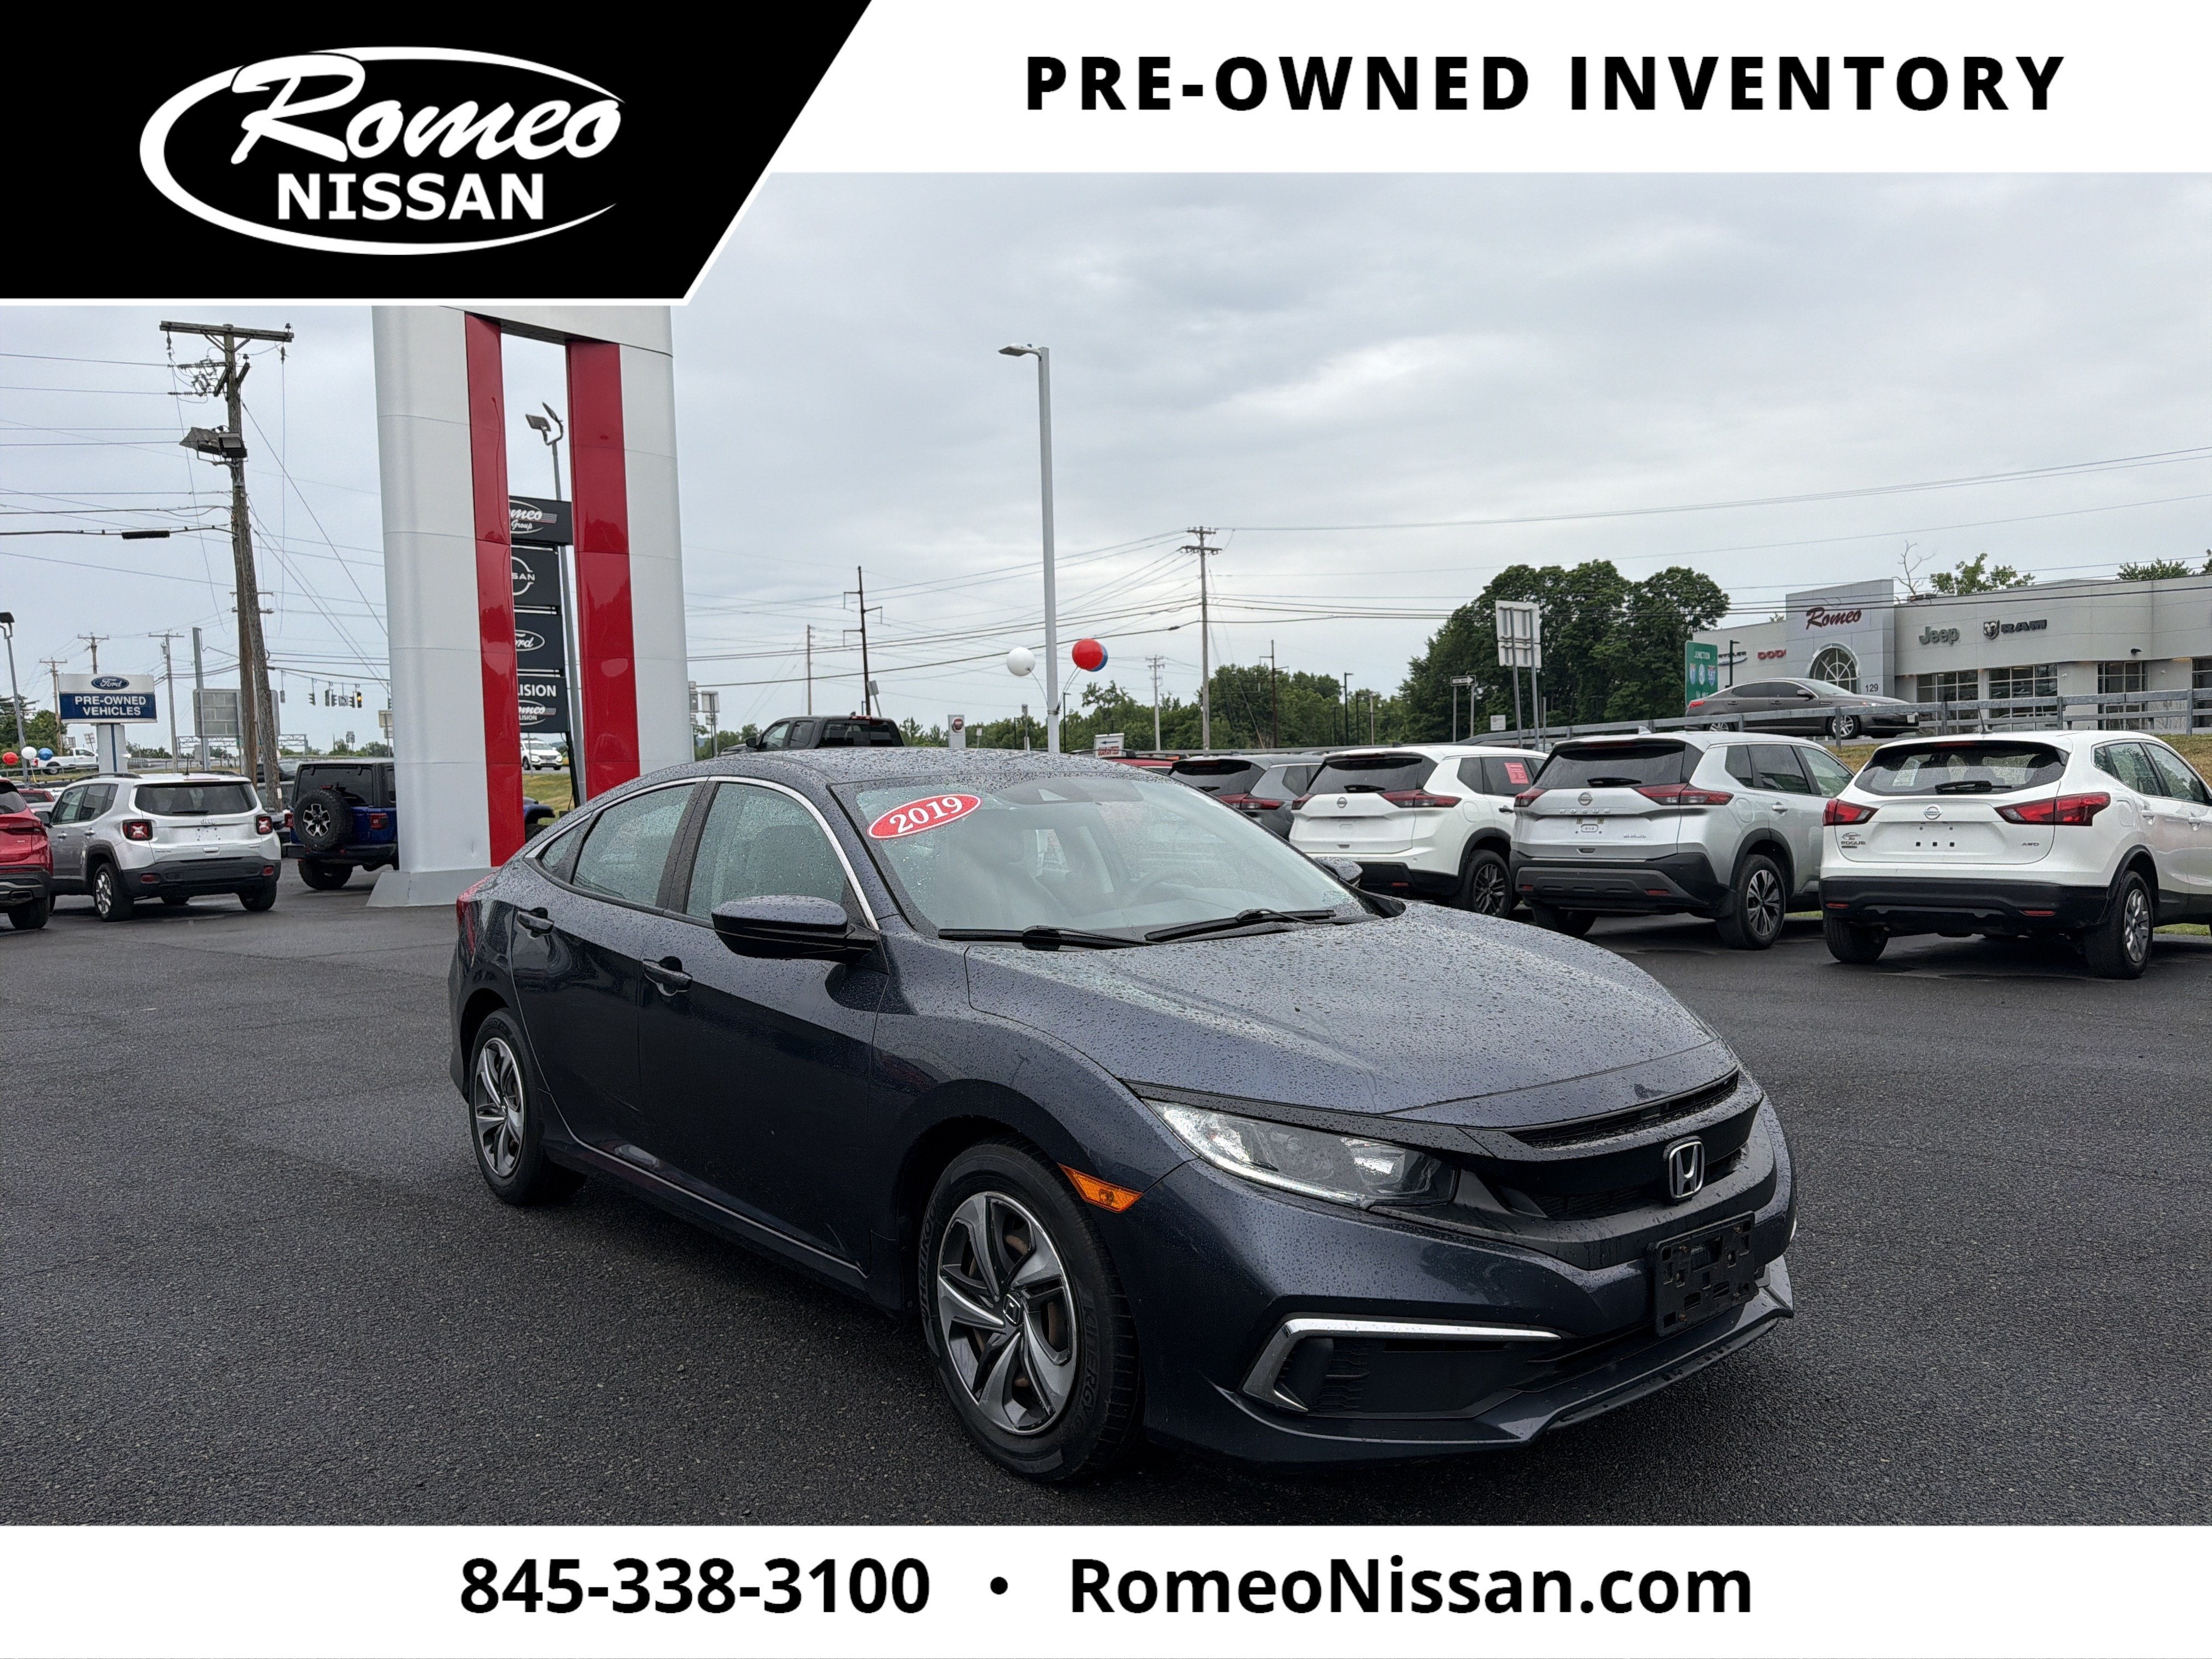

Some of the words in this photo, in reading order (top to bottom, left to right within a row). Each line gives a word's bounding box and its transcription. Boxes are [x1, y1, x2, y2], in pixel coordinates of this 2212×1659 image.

[510, 509, 543, 521] meo
[1805, 607, 1862, 630] Romeo
[2001, 619, 2047, 633] RAM
[1919, 626, 1960, 646] Jeep
[1757, 648, 1787, 660] DOD
[100, 678, 122, 687] Ford
[1865, 684, 1879, 693] 129
[517, 684, 556, 697] ISION
[75, 696, 146, 705] PRE-OWNED
[82, 706, 141, 716] VEHICLES
[889, 797, 963, 833] 2019
